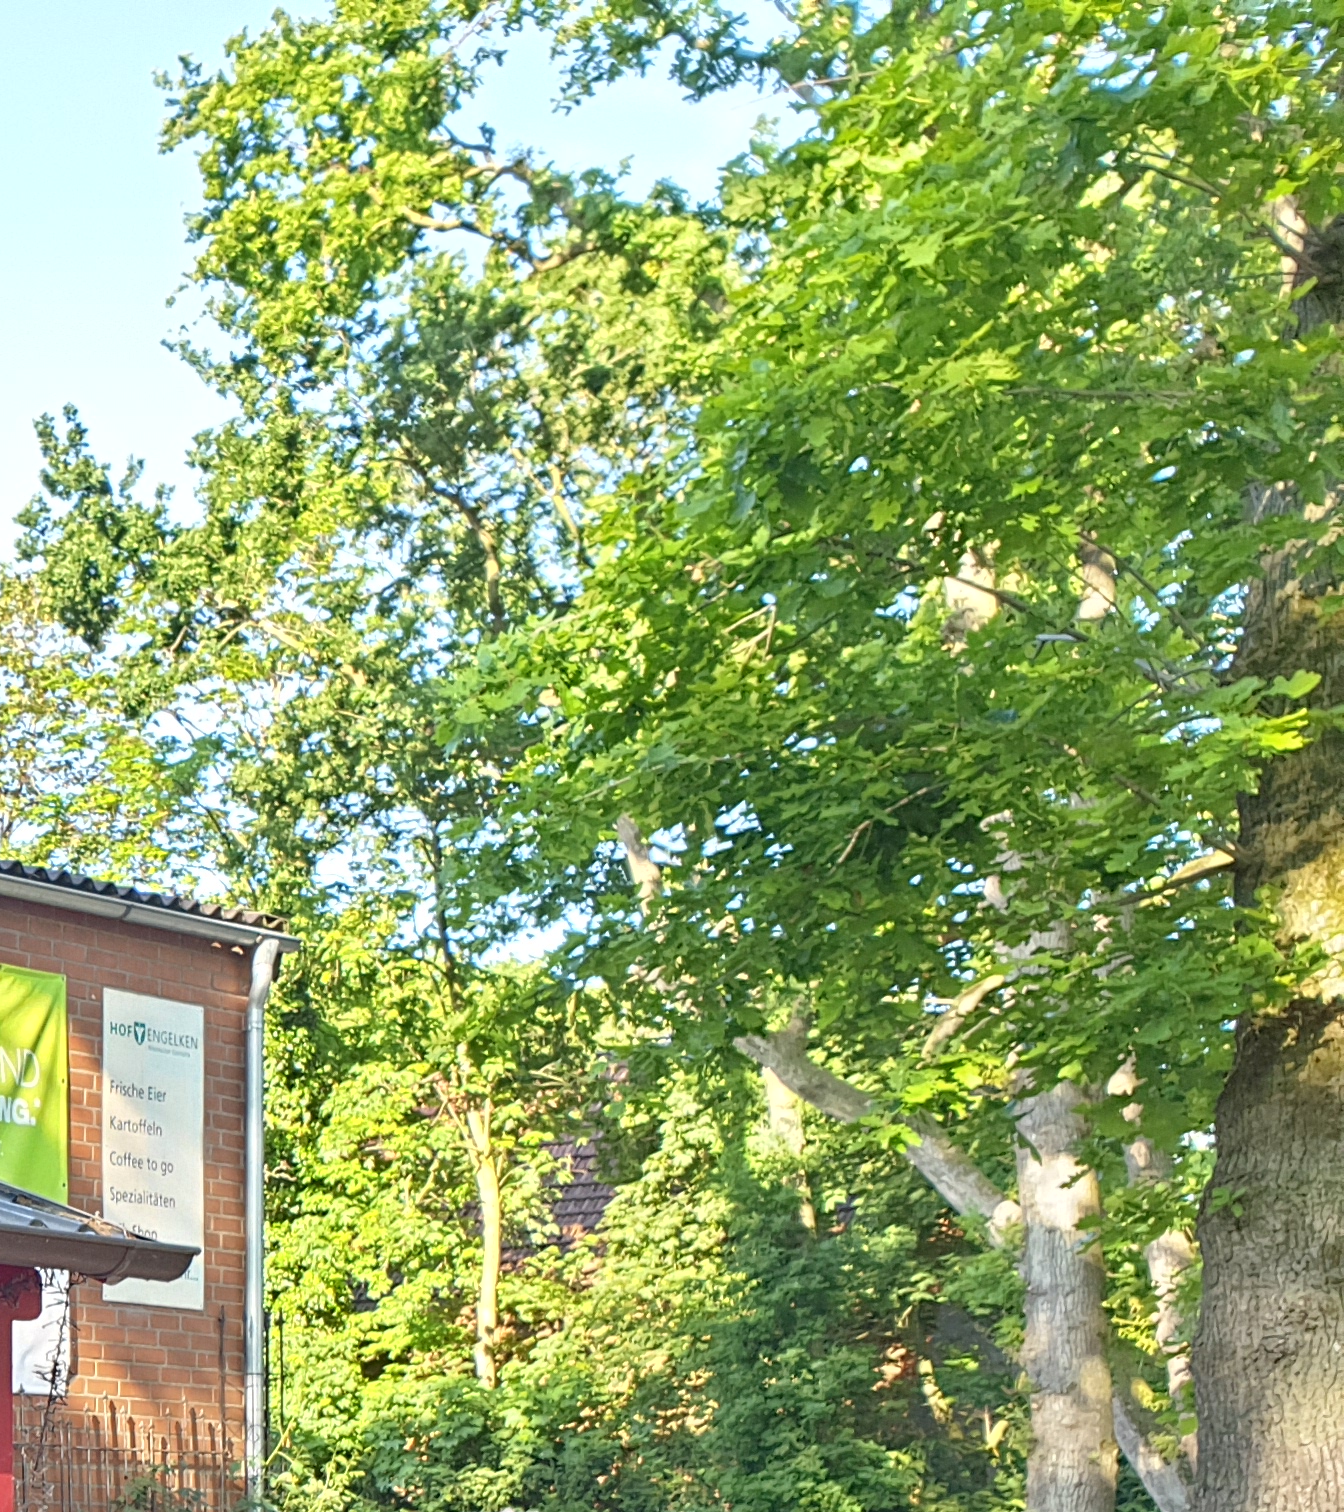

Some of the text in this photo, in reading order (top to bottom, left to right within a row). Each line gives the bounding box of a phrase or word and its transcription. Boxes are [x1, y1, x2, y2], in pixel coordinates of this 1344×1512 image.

[109, 1021, 198, 1050] HOF ENGELKEN
[109, 1080, 167, 1103] Frische Eier
[109, 1115, 163, 1137] Kartoffeln
[109, 1151, 175, 1177] Coffee to go
[109, 1186, 176, 1209] Spezialitäten
